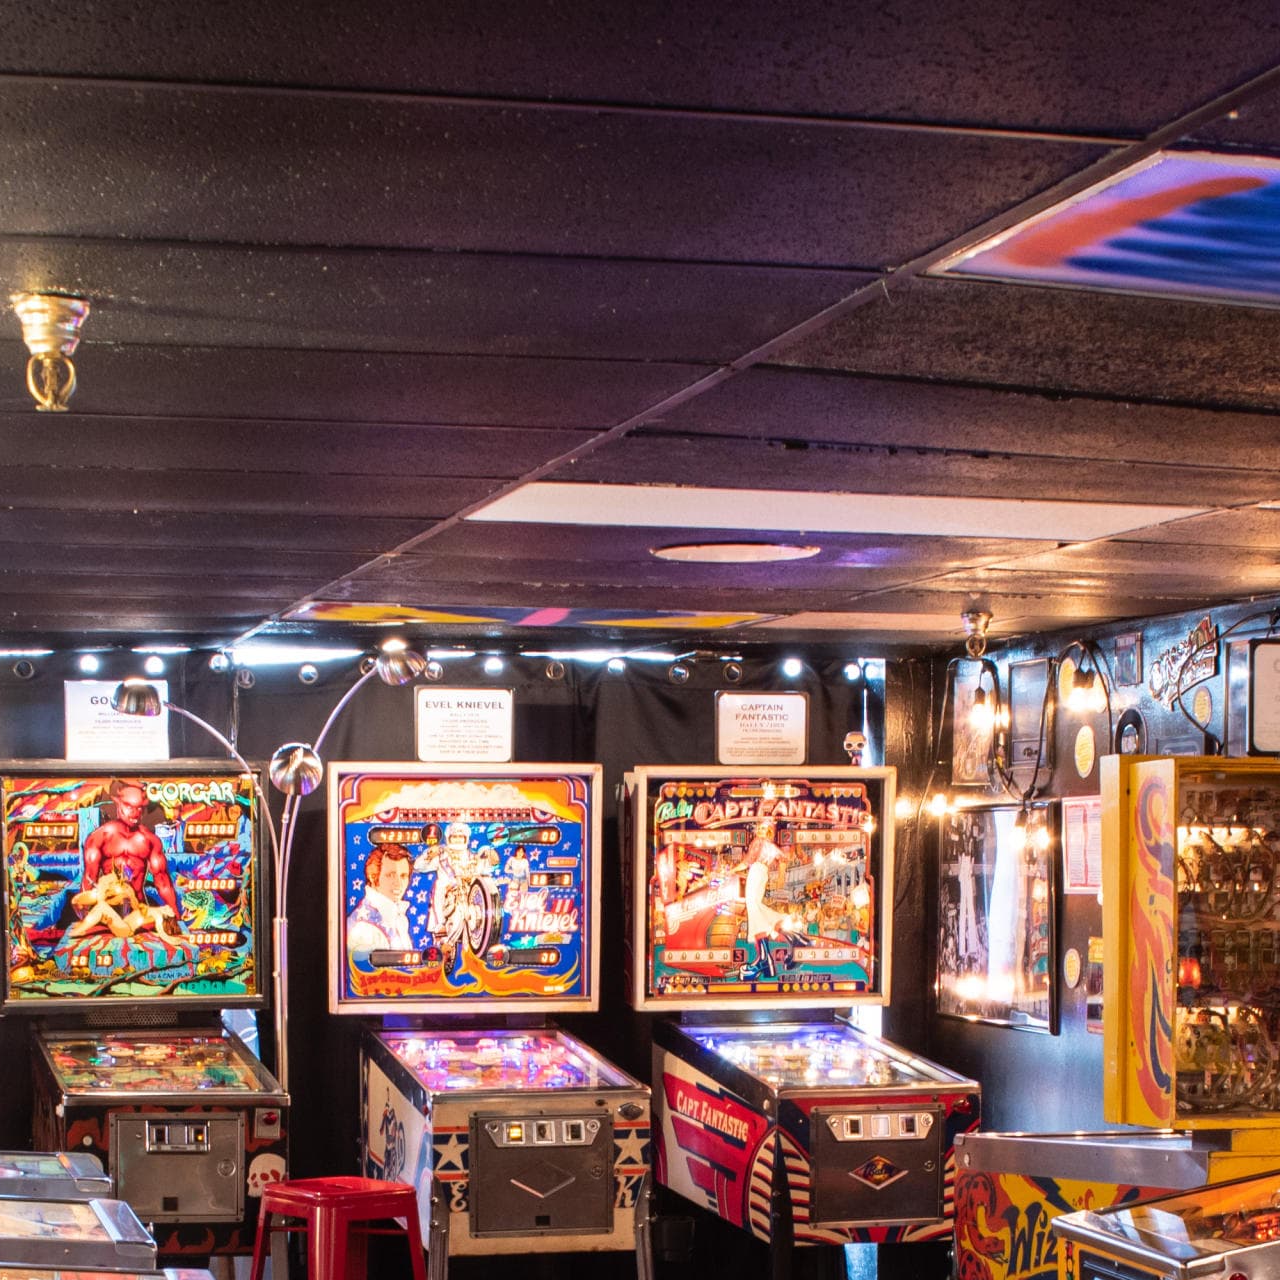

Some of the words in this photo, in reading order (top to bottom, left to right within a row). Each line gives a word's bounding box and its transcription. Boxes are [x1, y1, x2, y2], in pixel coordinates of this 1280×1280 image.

[425, 700, 453, 709] EVEL
[456, 700, 505, 710] KNIEVEL
[735, 713, 789, 721] FANTASTIC
[740, 703, 784, 712] CAPTAIN
[145, 781, 236, 808] GORGAR
[656, 801, 694, 823] Bally
[694, 800, 755, 826] CAPT.
[757, 798, 874, 828] FANTASTIC
[503, 886, 549, 912] Evel
[509, 908, 579, 933] Knievel
[676, 1089, 700, 1120] CAPT.
[700, 1100, 750, 1143] FANTASTIC
[1001, 1201, 1059, 1278] Wiz
